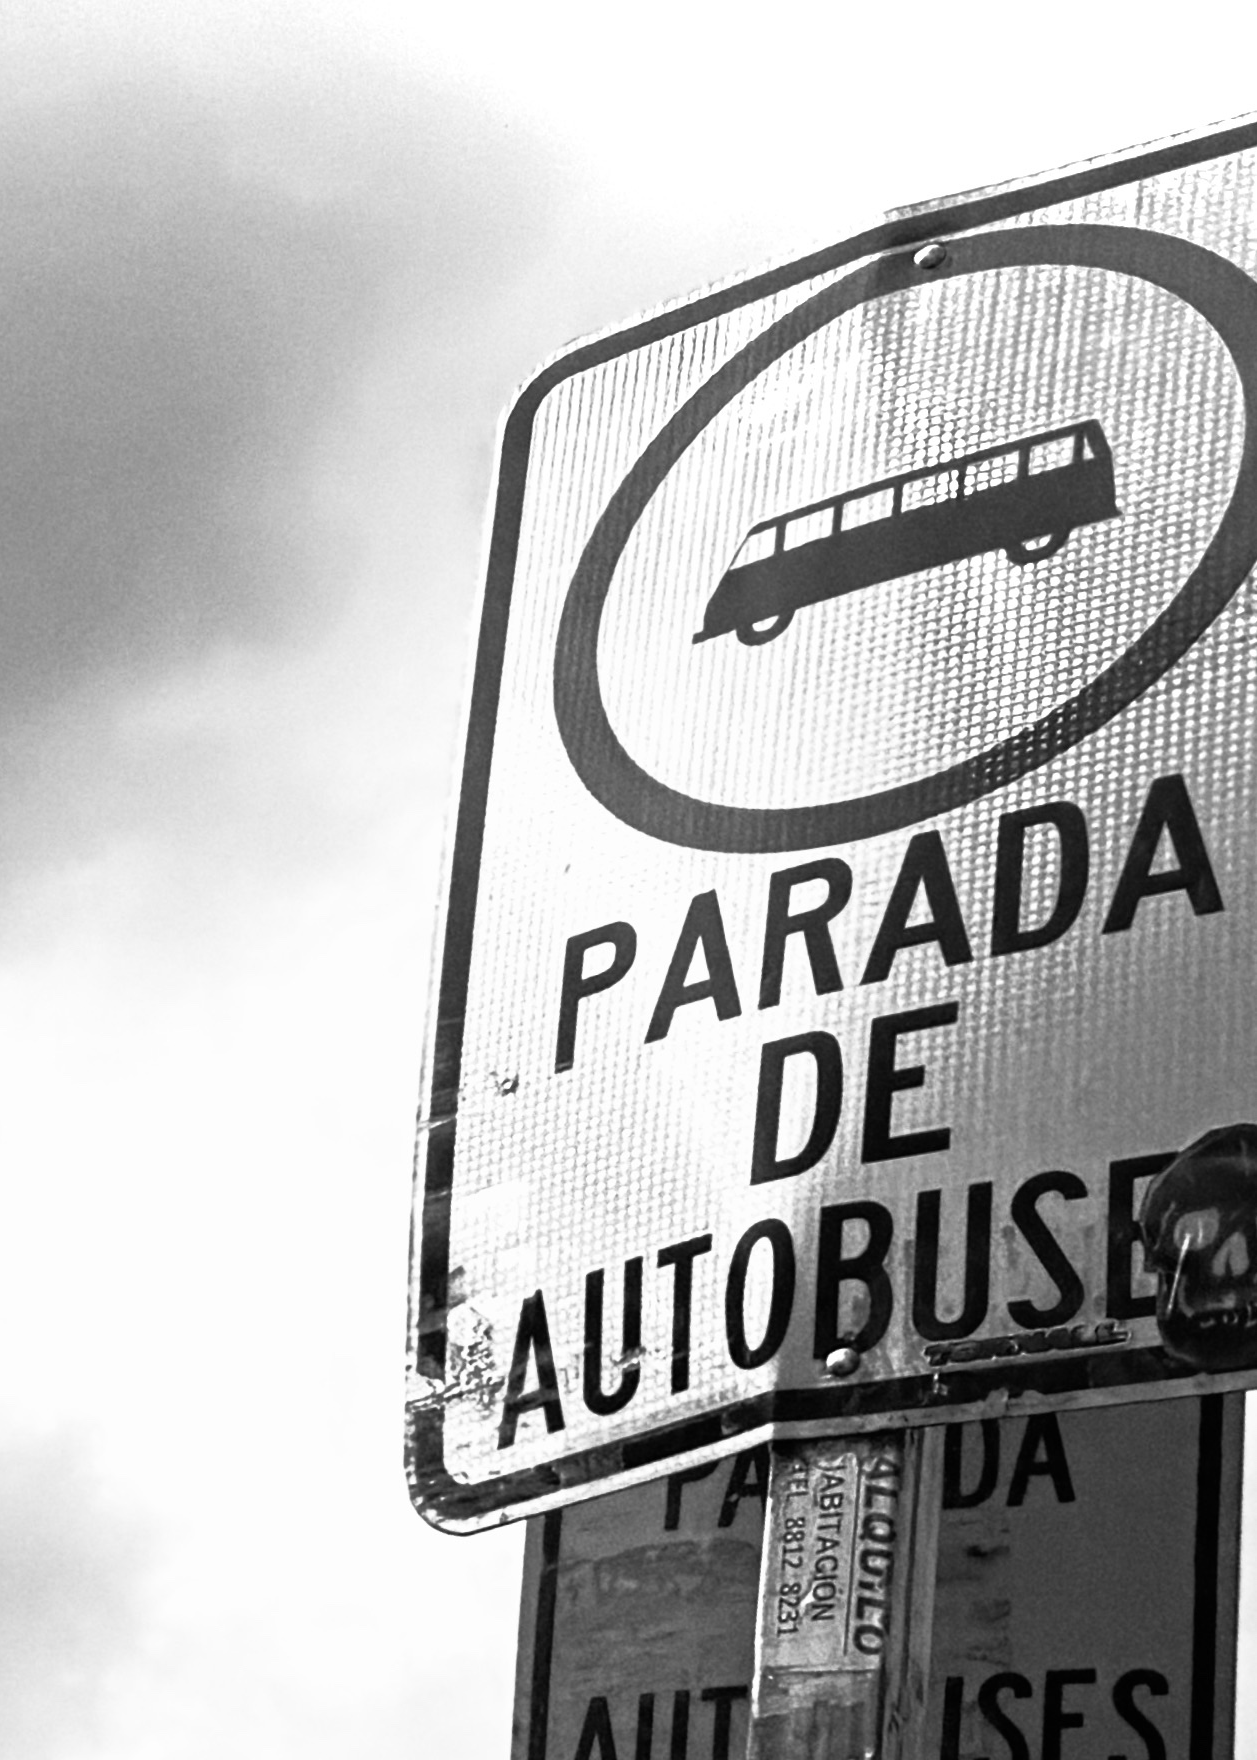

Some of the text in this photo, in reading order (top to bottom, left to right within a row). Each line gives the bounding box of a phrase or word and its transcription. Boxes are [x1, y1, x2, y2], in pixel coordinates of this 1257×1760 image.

[555, 774, 1224, 1073] PARADA
[750, 1002, 959, 1186] DE
[498, 1152, 1181, 1450] AUTOBUSE
[664, 1412, 1075, 1531] PADA
[782, 1516, 806, 1571] 8812
[853, 1457, 900, 1655] ALQUILO
[777, 1583, 801, 1637] 8231
